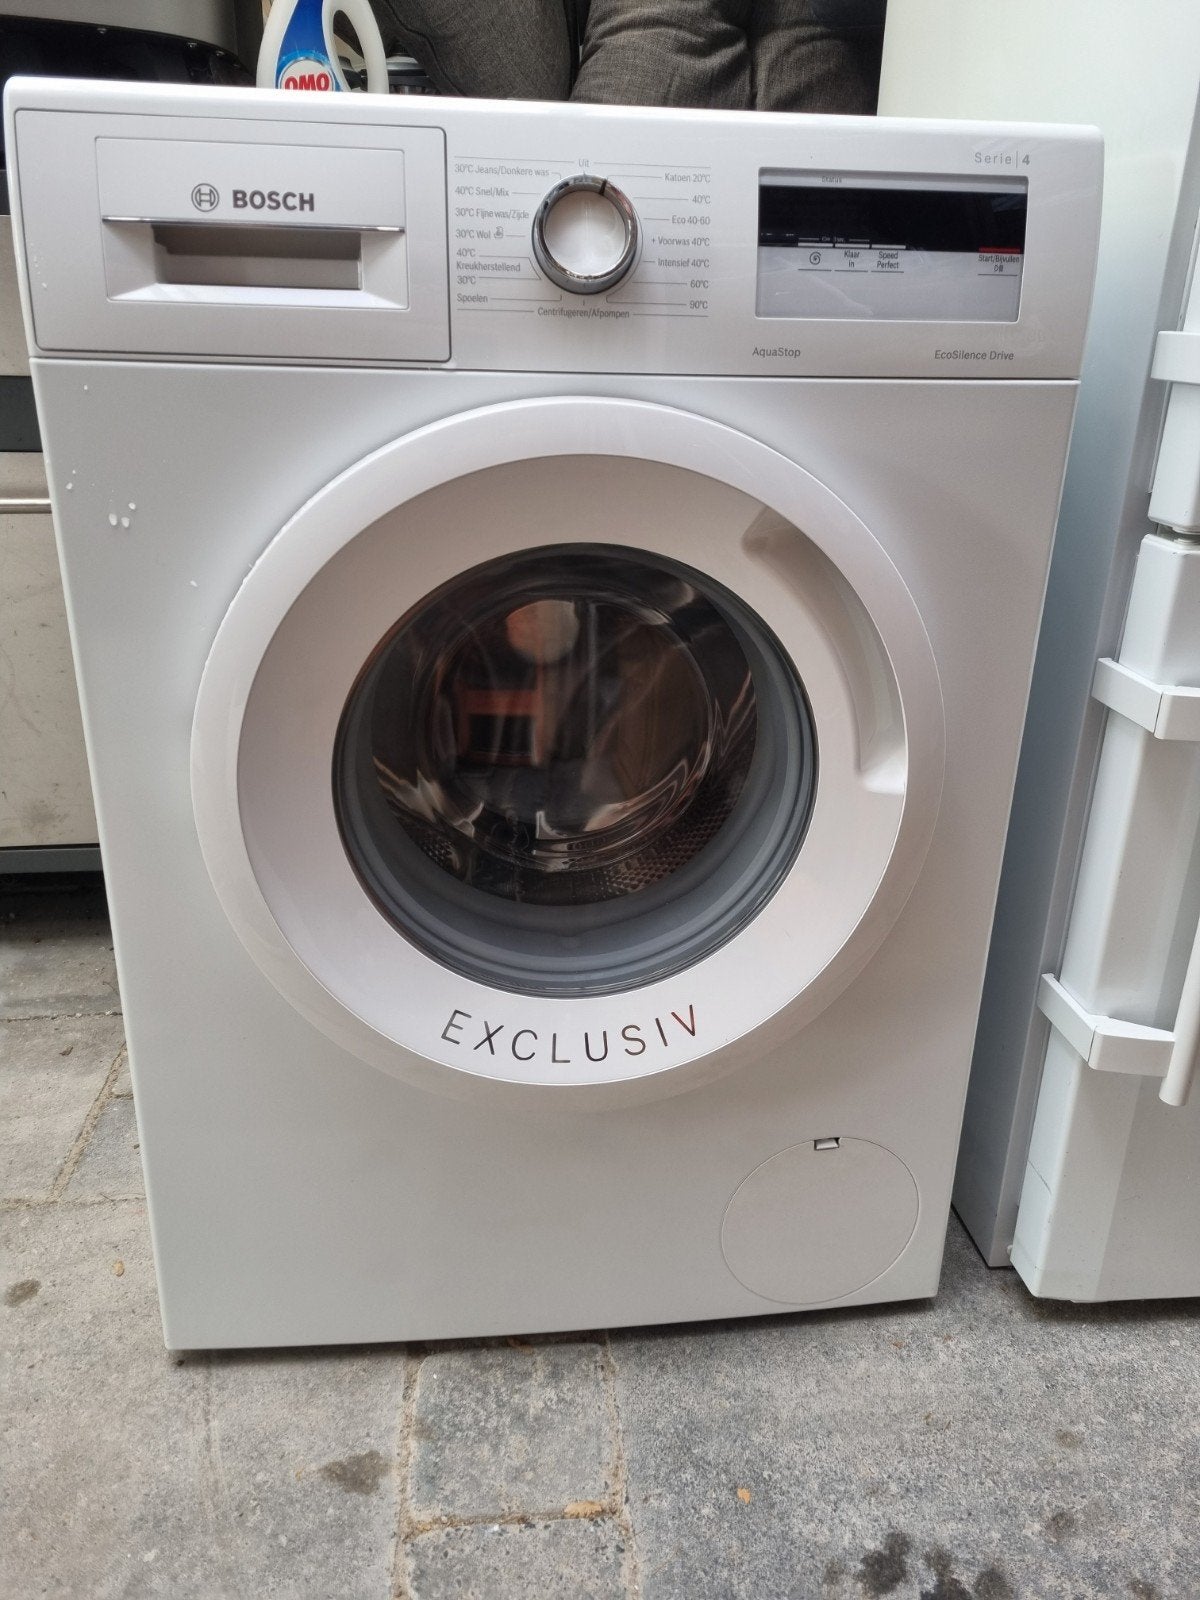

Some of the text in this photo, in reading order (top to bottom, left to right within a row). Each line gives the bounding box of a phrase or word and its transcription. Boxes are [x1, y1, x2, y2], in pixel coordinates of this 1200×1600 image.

[284, 72, 330, 91] OMO
[579, 159, 589, 167] Uit
[974, 152, 1030, 166] Serie 4
[454, 163, 474, 173] 30°C
[474, 164, 533, 176] Jeans/Donkere
[664, 173, 711, 183] Katoen 20°C
[454, 186, 509, 197] 40°C Snel/Mix
[232, 189, 315, 212] BOSCH
[692, 195, 711, 204] 40°C
[455, 207, 474, 217] 30°C
[671, 215, 711, 225] Eco 40-60
[455, 229, 491, 239] 30°C Wol
[658, 236, 690, 246] Voorwas
[691, 237, 710, 247] 40°C
[456, 248, 476, 257] 40°C
[844, 251, 860, 259] Klaar
[878, 251, 899, 260] Speed
[456, 261, 521, 272] Kreukherstellend
[658, 258, 710, 268] Intensief 40°C
[876, 261, 899, 269] Perfect
[456, 275, 476, 285] 30°C
[690, 280, 709, 289] 60°C
[456, 293, 488, 303] Spoelen
[689, 300, 708, 309] 90°C
[537, 306, 630, 318] Centrifugeren/Afpompen
[751, 346, 801, 358] AquaStop
[934, 349, 1015, 361] EcoSilence Drive
[440, 1004, 697, 1064] EXCLUSIV
